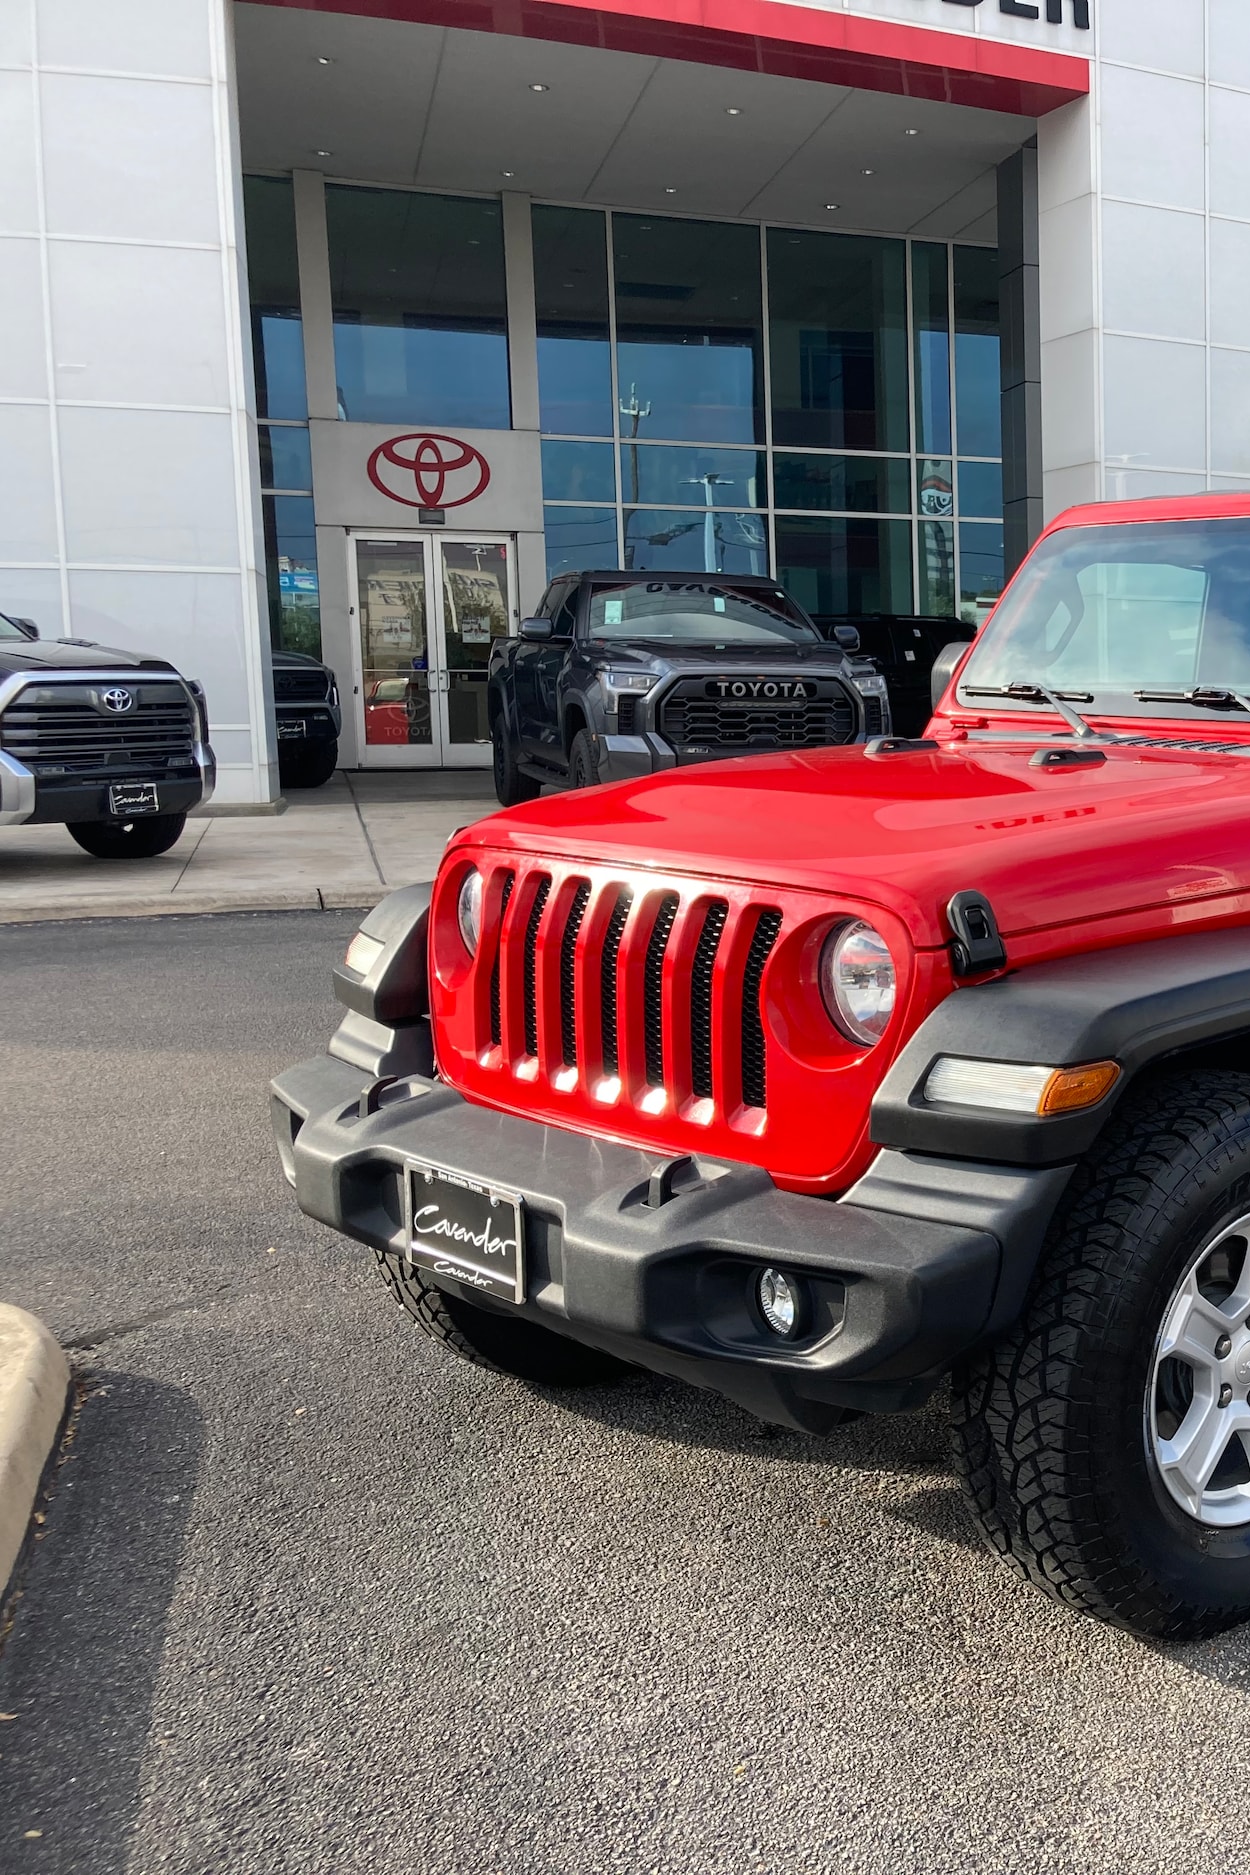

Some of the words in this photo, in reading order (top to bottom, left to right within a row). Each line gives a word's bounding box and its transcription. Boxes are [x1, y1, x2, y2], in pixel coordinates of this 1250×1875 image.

[717, 682, 807, 698] TOYOTA
[414, 1205, 517, 1256] Cavender
[433, 1261, 493, 1287] Cavender
